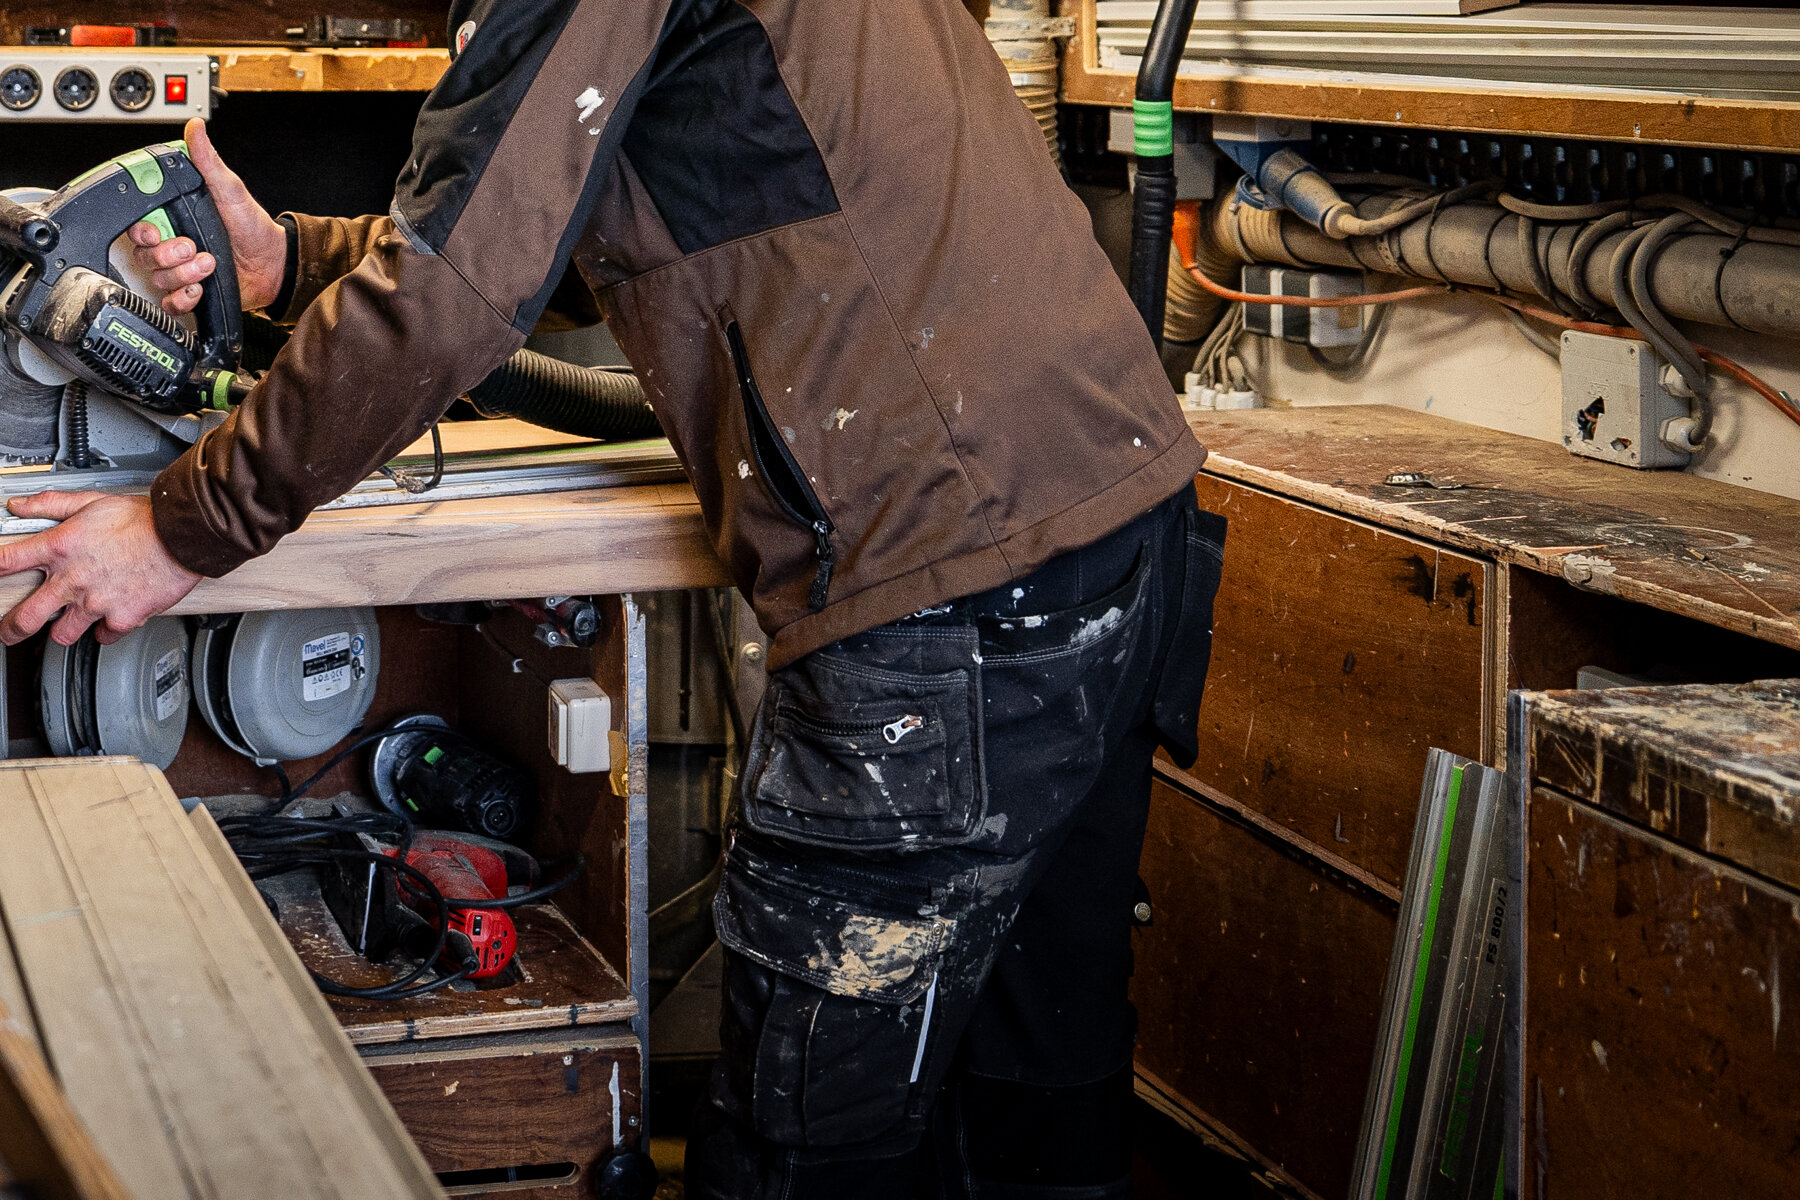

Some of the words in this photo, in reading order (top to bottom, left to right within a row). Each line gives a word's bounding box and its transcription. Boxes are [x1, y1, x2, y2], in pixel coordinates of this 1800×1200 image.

[108, 320, 177, 373] FESTOOL
[1491, 886, 1507, 939] 800/2
[1486, 943, 1498, 965] FS
